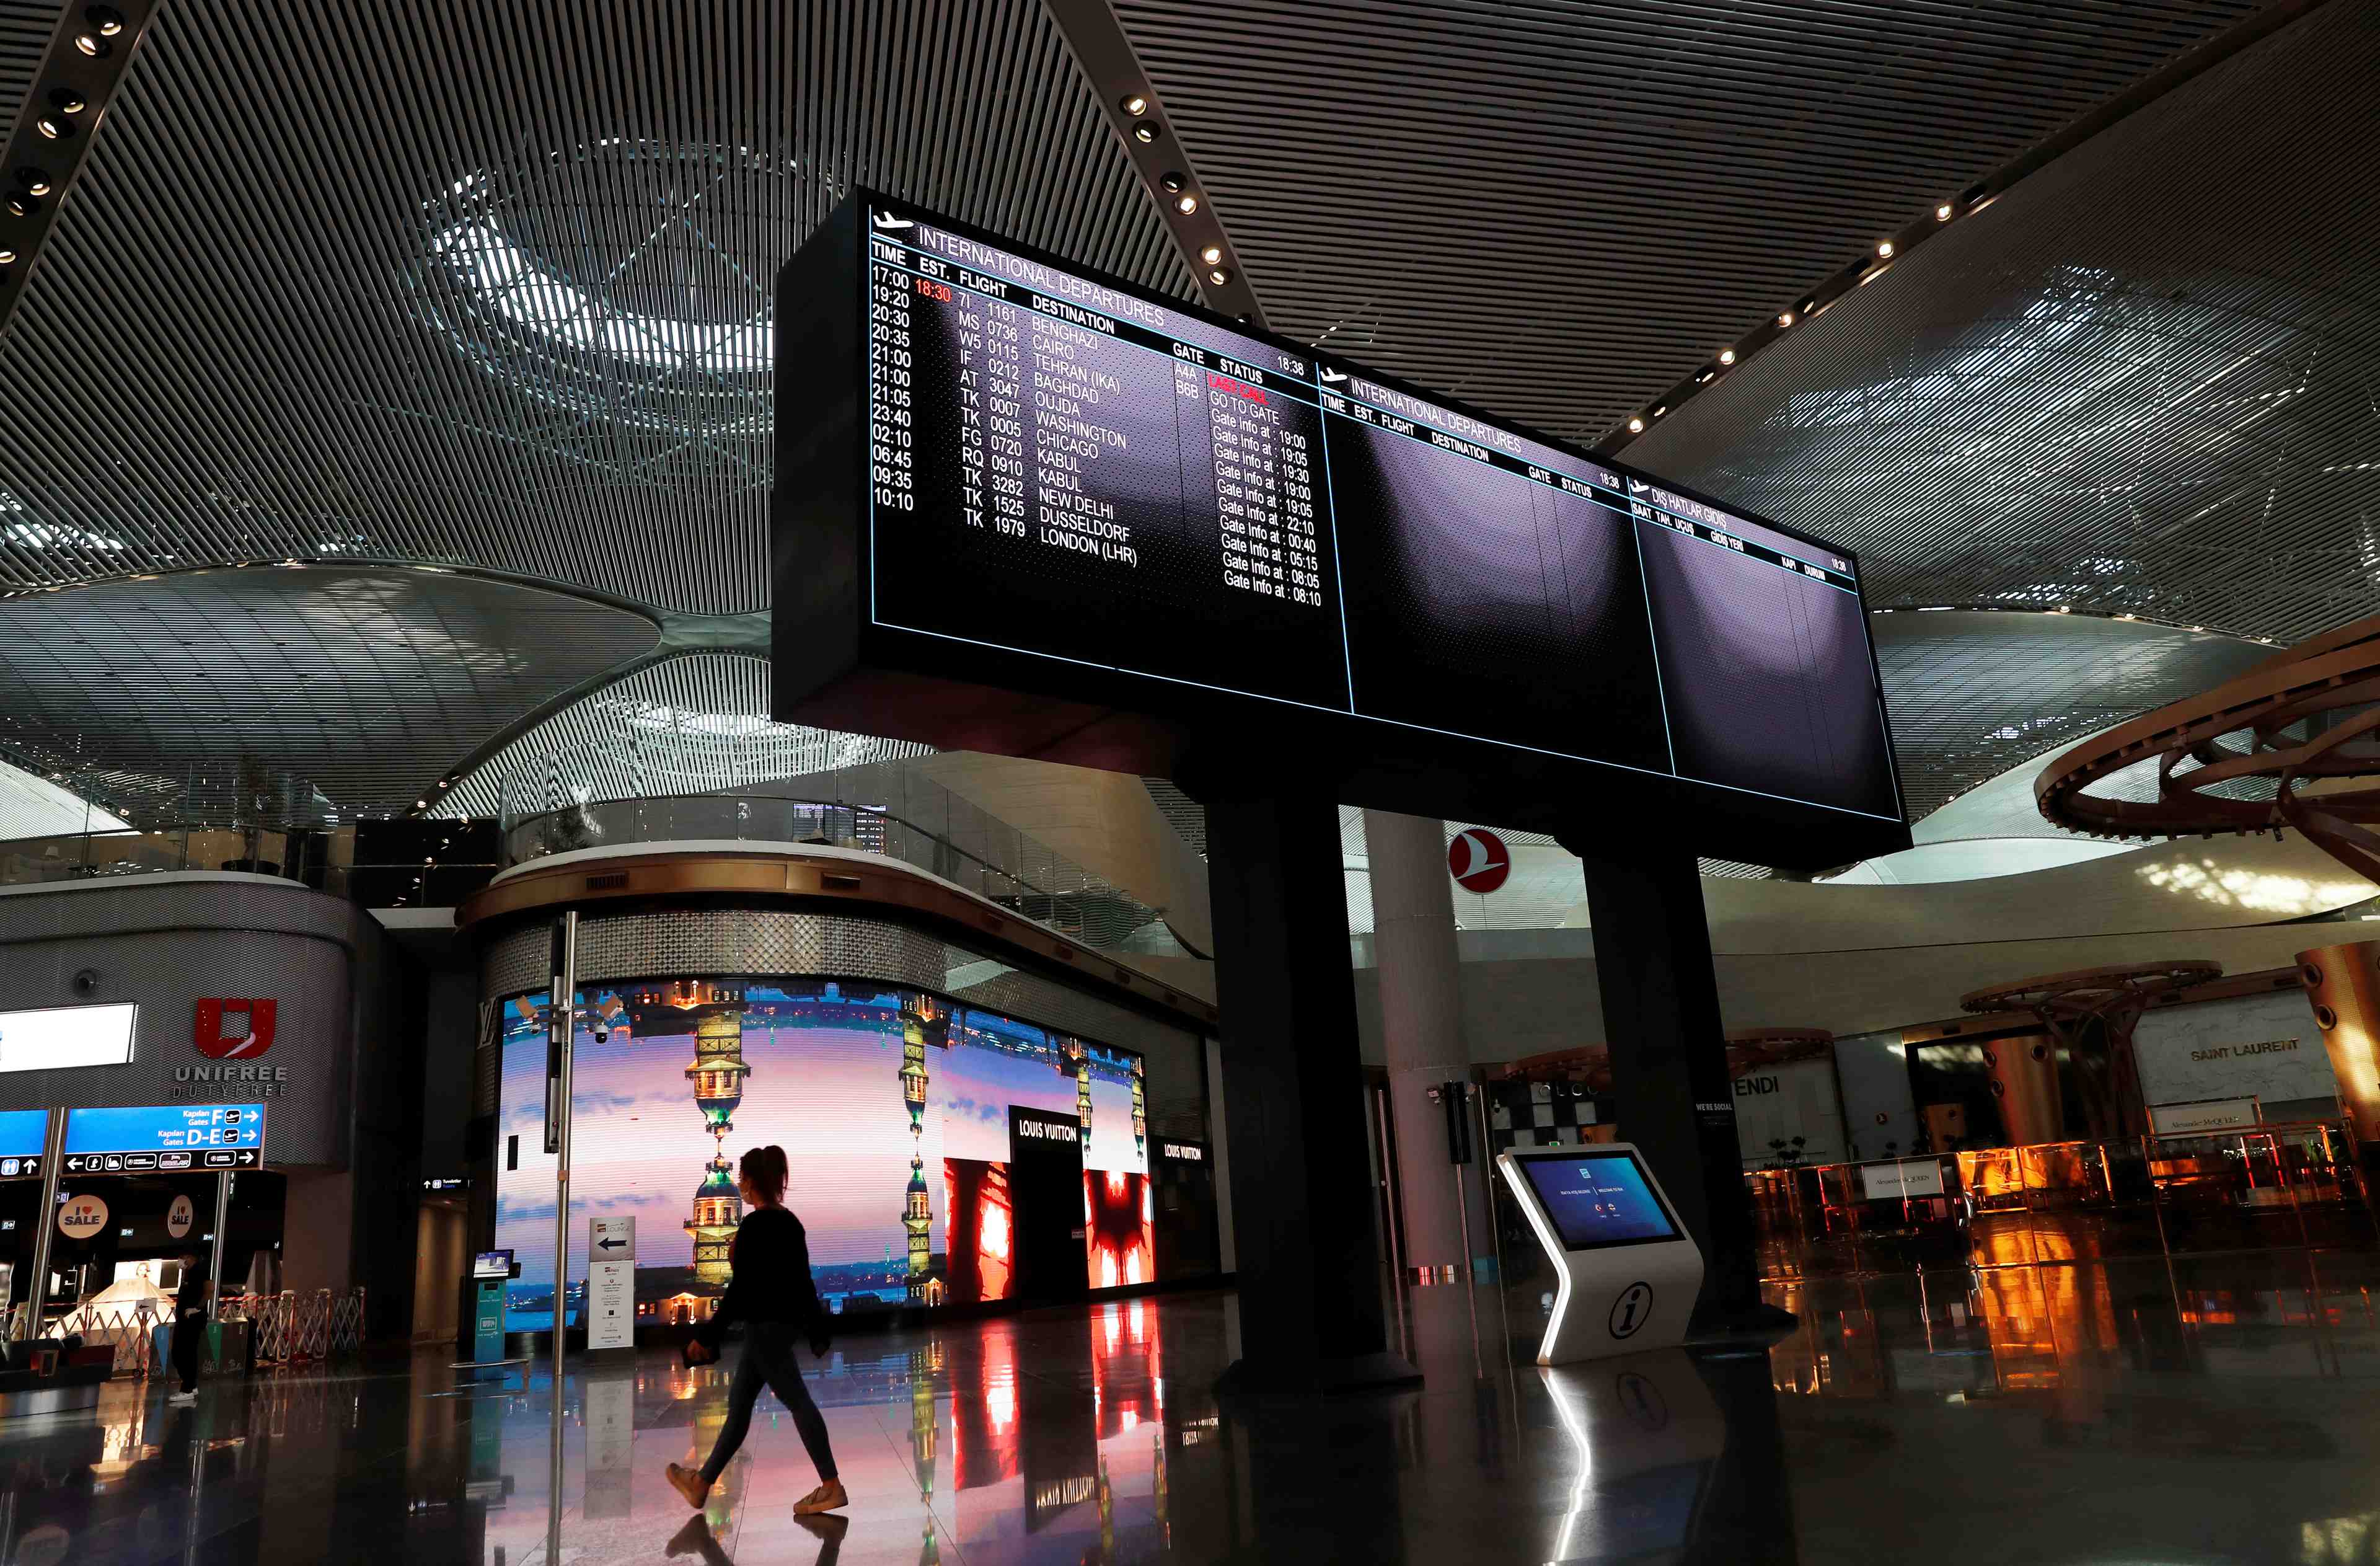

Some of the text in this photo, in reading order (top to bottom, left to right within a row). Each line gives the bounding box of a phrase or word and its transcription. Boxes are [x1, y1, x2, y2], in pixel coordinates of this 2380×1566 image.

[873, 241, 1263, 384] TIME EST. FLIGHT DESTINATION GATE STATUS
[873, 266, 909, 289] 17:00
[916, 279, 951, 302] 18:30
[959, 292, 970, 309] 7I
[988, 302, 1016, 323] 1161
[1033, 316, 1098, 350] BENGHAZI
[1175, 362, 1197, 381] A4A
[1240, 384, 1269, 405] CALL
[873, 285, 1279, 425] 19:20 MS 0736 CAIRO B6B GO TO GATE
[920, 226, 1303, 376] INTERNATIONAL DEPARTURES 18:38
[873, 304, 1305, 449] 20:30 W5 0115 TEHRAN (IKA) Gate Info at 19:00
[873, 324, 1307, 466] 20:35 IF 0212 BAGHDAD Gate Info at 19:05
[873, 343, 1309, 484] 21:00 AT 3047 OUJDA Gate Info at 19:30
[873, 363, 1310, 500] 21:00 TK 0007 WASHINGTON Gate Info at 19:00
[873, 383, 1312, 518] 21:05 TK 0005 CHICAGO Gate Info at 19:05
[873, 404, 1314, 536] 23:40 FG 0720 KABUL Gate Info at 22:10
[873, 424, 1315, 553] 02:10 RQ 0910 KABUL Gate Info at 00:40
[1322, 394, 1592, 498] TIME EST. FLIGHT DESTINATION GATE STATUS
[1351, 379, 1620, 489] INTERNATIONAL DEPARTURES 18:38
[873, 445, 1318, 570] 06:45 TK 3282 NEW DELHI Gate Info at 05:15
[873, 466, 1319, 589] 09:35 TK 1525 DUSSELDORF Gate Info at 08:05
[875, 487, 1321, 606] 10:10 TK 1979 LONDON (LHR) Gate Info at 08:10
[1633, 503, 1651, 519] SAAT
[1656, 511, 1672, 526] TAH.
[1675, 518, 1694, 536] UÇUŞ
[1804, 565, 1825, 580] DURUM
[1652, 489, 1667, 509] DIŞ
[1668, 495, 1703, 520] HATLAR
[1704, 508, 1727, 531] GİDİŞ
[176, 1066, 287, 1081] UNIFREE
[1735, 1076, 1779, 1096] ENDI
[2192, 1038, 2299, 1061] SAINT LAURENT
[187, 1129, 221, 1145] D-E
[211, 1110, 223, 1125] F
[1020, 1120, 1077, 1142] LOUIS VUITTON
[1165, 1144, 1201, 1160] LOUIS VUITTON
[64, 1215, 100, 1225] SALE
[76, 1206, 80, 1215] I
[172, 1215, 188, 1225] SALE
